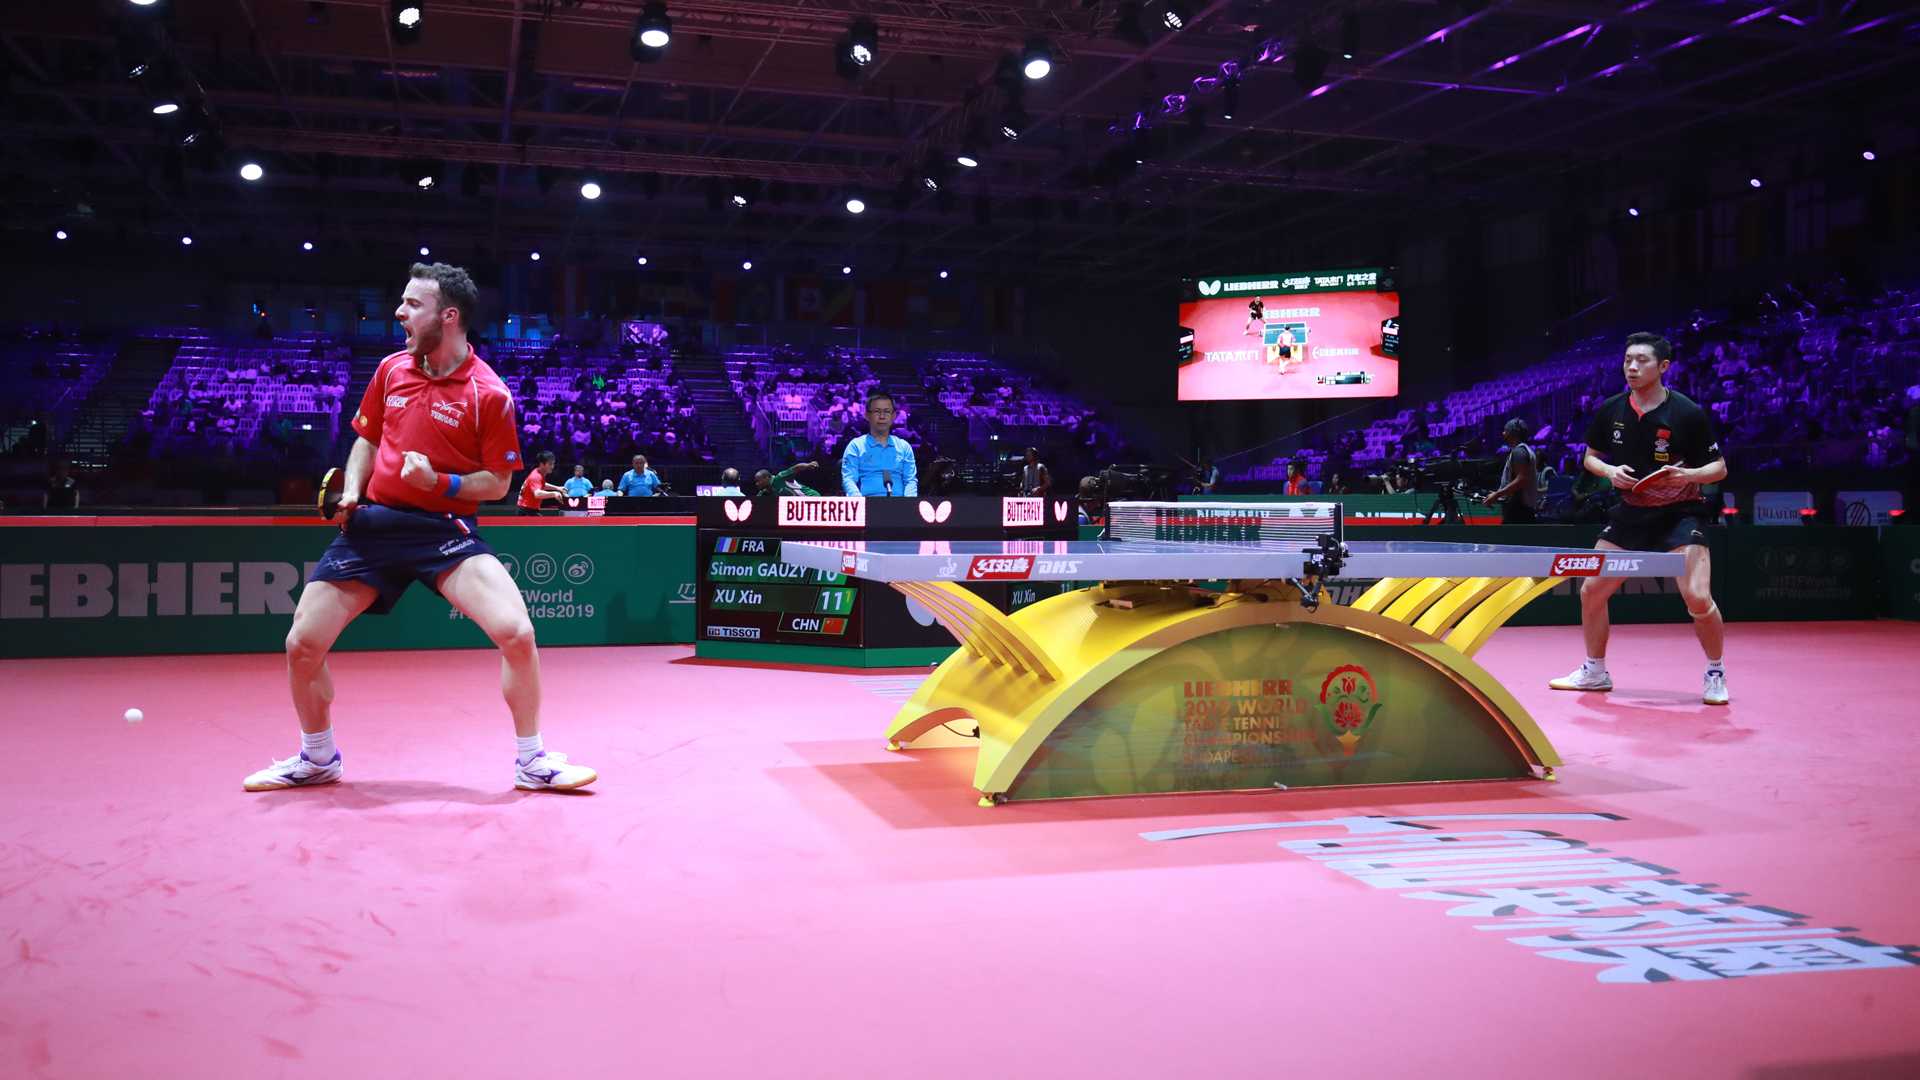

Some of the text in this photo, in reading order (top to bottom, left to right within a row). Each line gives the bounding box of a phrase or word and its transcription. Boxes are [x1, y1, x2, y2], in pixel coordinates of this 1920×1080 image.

[786, 500, 859, 521] BUTTERFLY
[1006, 501, 1041, 522] BUTTERFLY
[741, 540, 765, 553] FRA
[710, 561, 753, 577] Simon
[757, 562, 808, 579] GAUZY
[1037, 560, 1084, 574] DHS
[1606, 559, 1643, 572] DHS
[714, 588, 736, 604] XU
[738, 589, 763, 605] Xin
[821, 591, 843, 611] 11
[1011, 590, 1023, 606] XU
[791, 617, 820, 631] CHN
[722, 628, 759, 638] TISSOT
